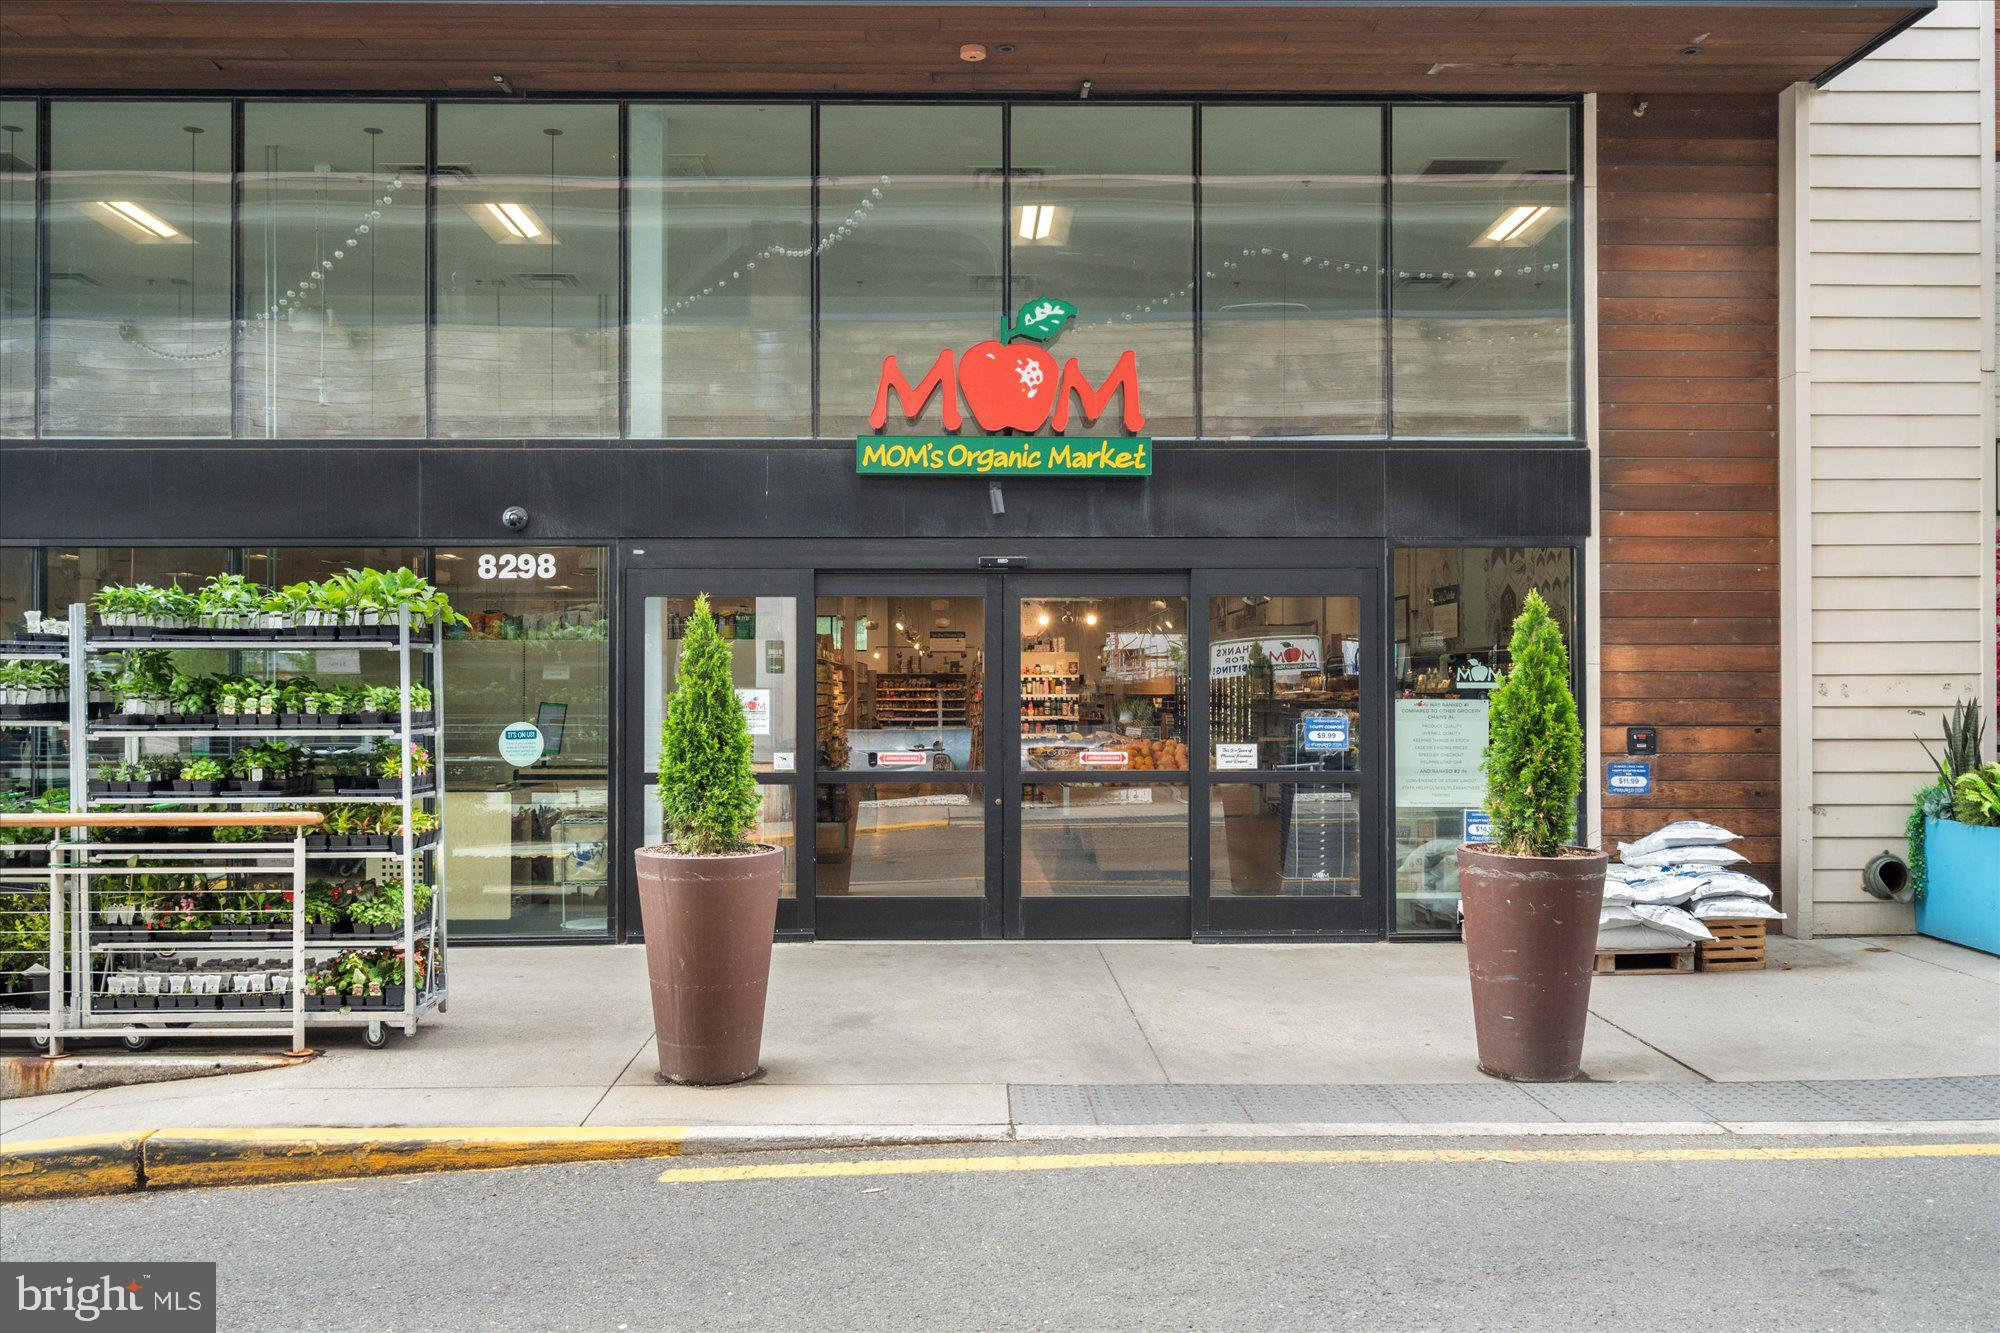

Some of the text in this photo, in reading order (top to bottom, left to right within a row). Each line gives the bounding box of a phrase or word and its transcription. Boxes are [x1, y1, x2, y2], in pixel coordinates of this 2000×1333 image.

[868, 336, 1145, 433] MOM
[862, 440, 1147, 473] MOM's Organic Market
[477, 553, 557, 580] 8298
